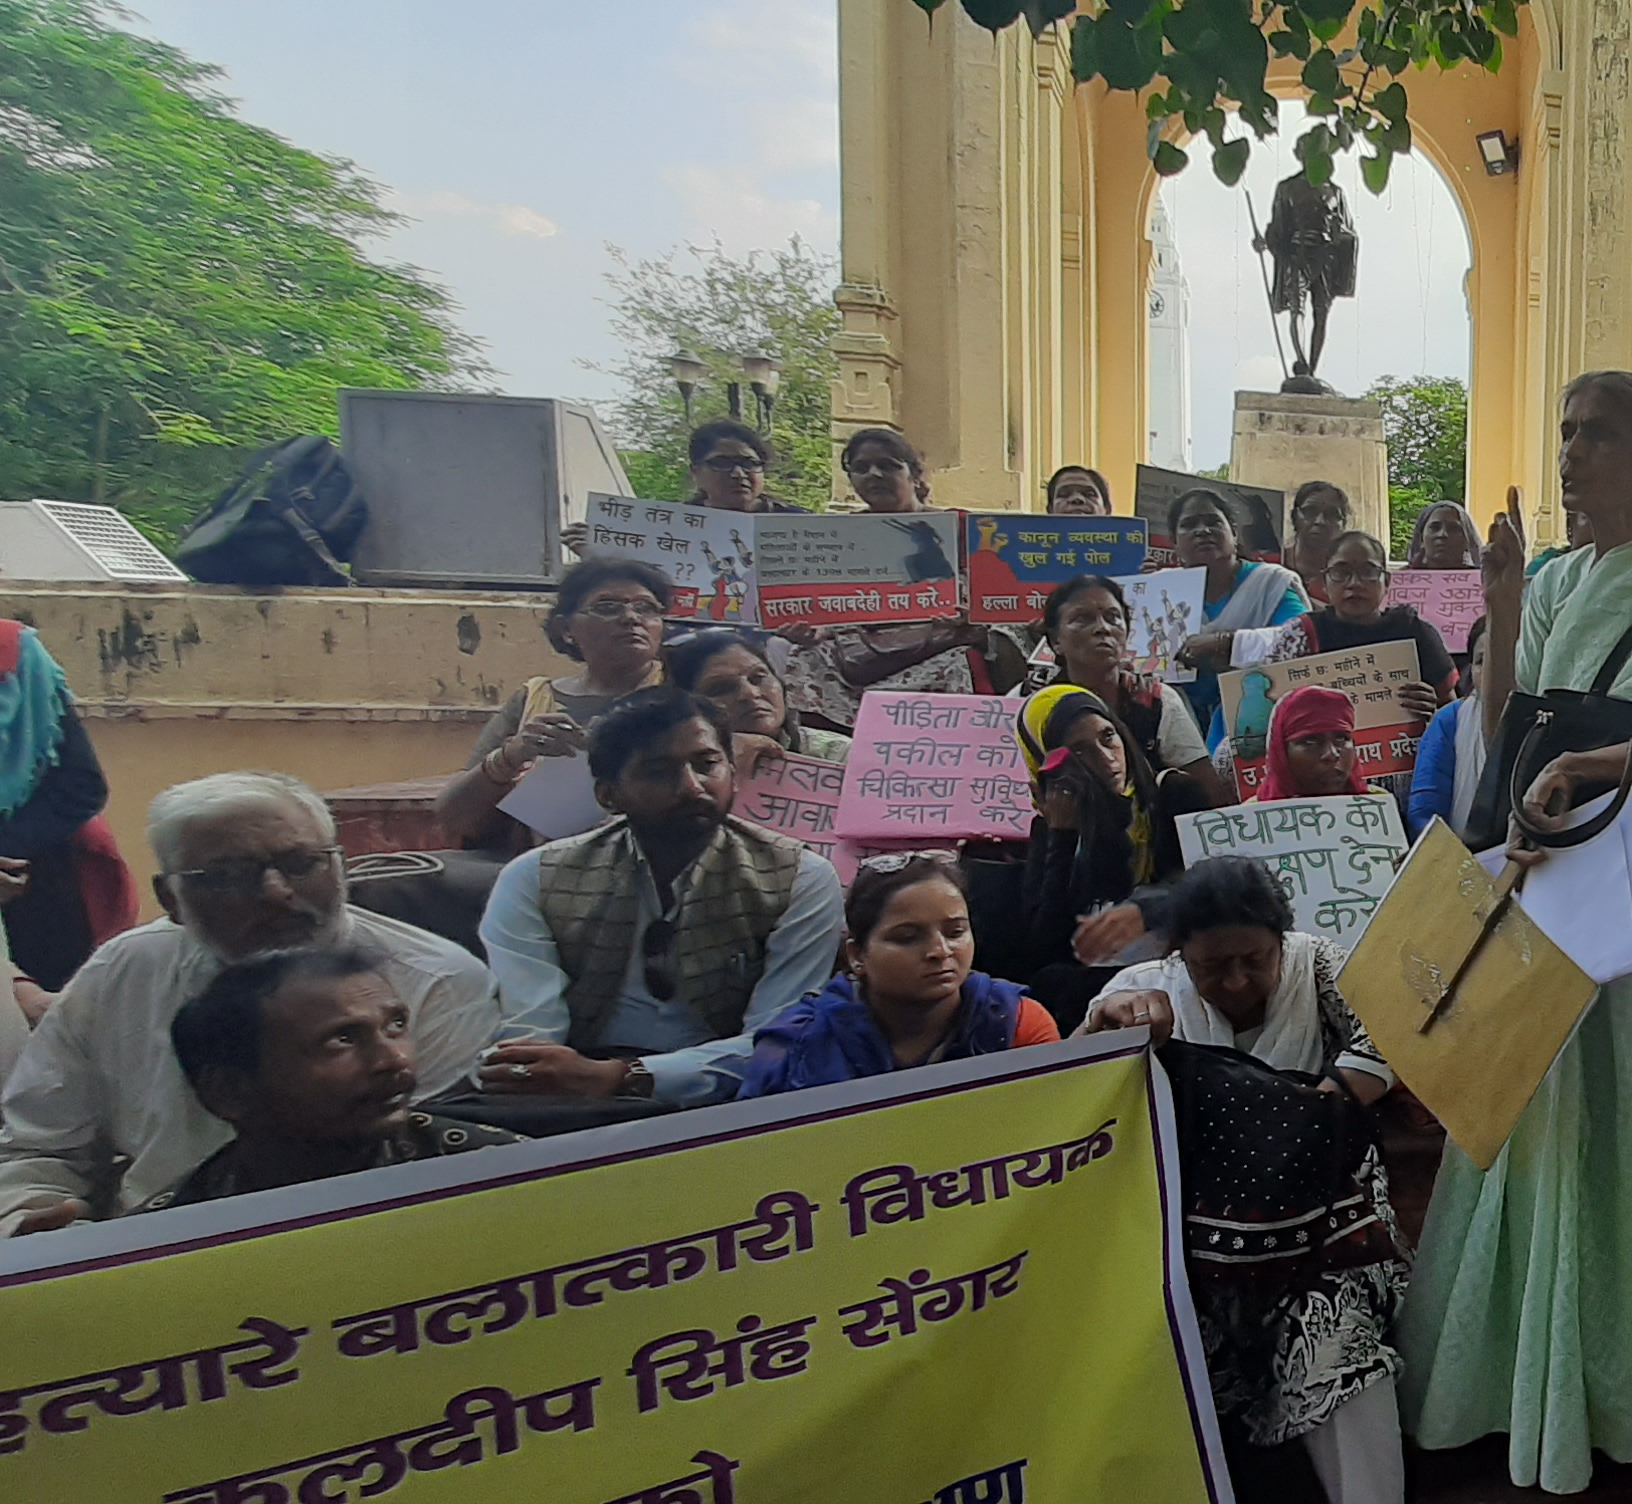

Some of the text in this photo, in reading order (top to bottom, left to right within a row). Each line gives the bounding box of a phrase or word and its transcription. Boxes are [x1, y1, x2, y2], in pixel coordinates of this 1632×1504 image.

[646, 505, 674, 525] तंत्र
[684, 512, 707, 529] का
[657, 532, 691, 554] खेल
[1018, 531, 1060, 548] कानून
[1068, 532, 1118, 544] व्यवस्था
[1018, 548, 1111, 568] खुल गई पोल
[764, 597, 813, 617] सरकार
[887, 593, 910, 610] तय
[982, 595, 1018, 611] हल्ला
[1334, 656, 1360, 672] महीने
[1366, 653, 1375, 666] में
[1373, 670, 1383, 682] के
[1365, 687, 1392, 702] मामले
[977, 735, 1018, 768] को
[857, 769, 964, 799] चिकित्सा
[881, 804, 953, 825] प्रदान
[1193, 797, 1386, 855] विधायक को
[332, 1191, 819, 1357] बलात्कारी
[841, 1118, 1118, 1239] विधायक
[626, 1314, 817, 1415] सिंह
[838, 1248, 1030, 1350] सेंगर
